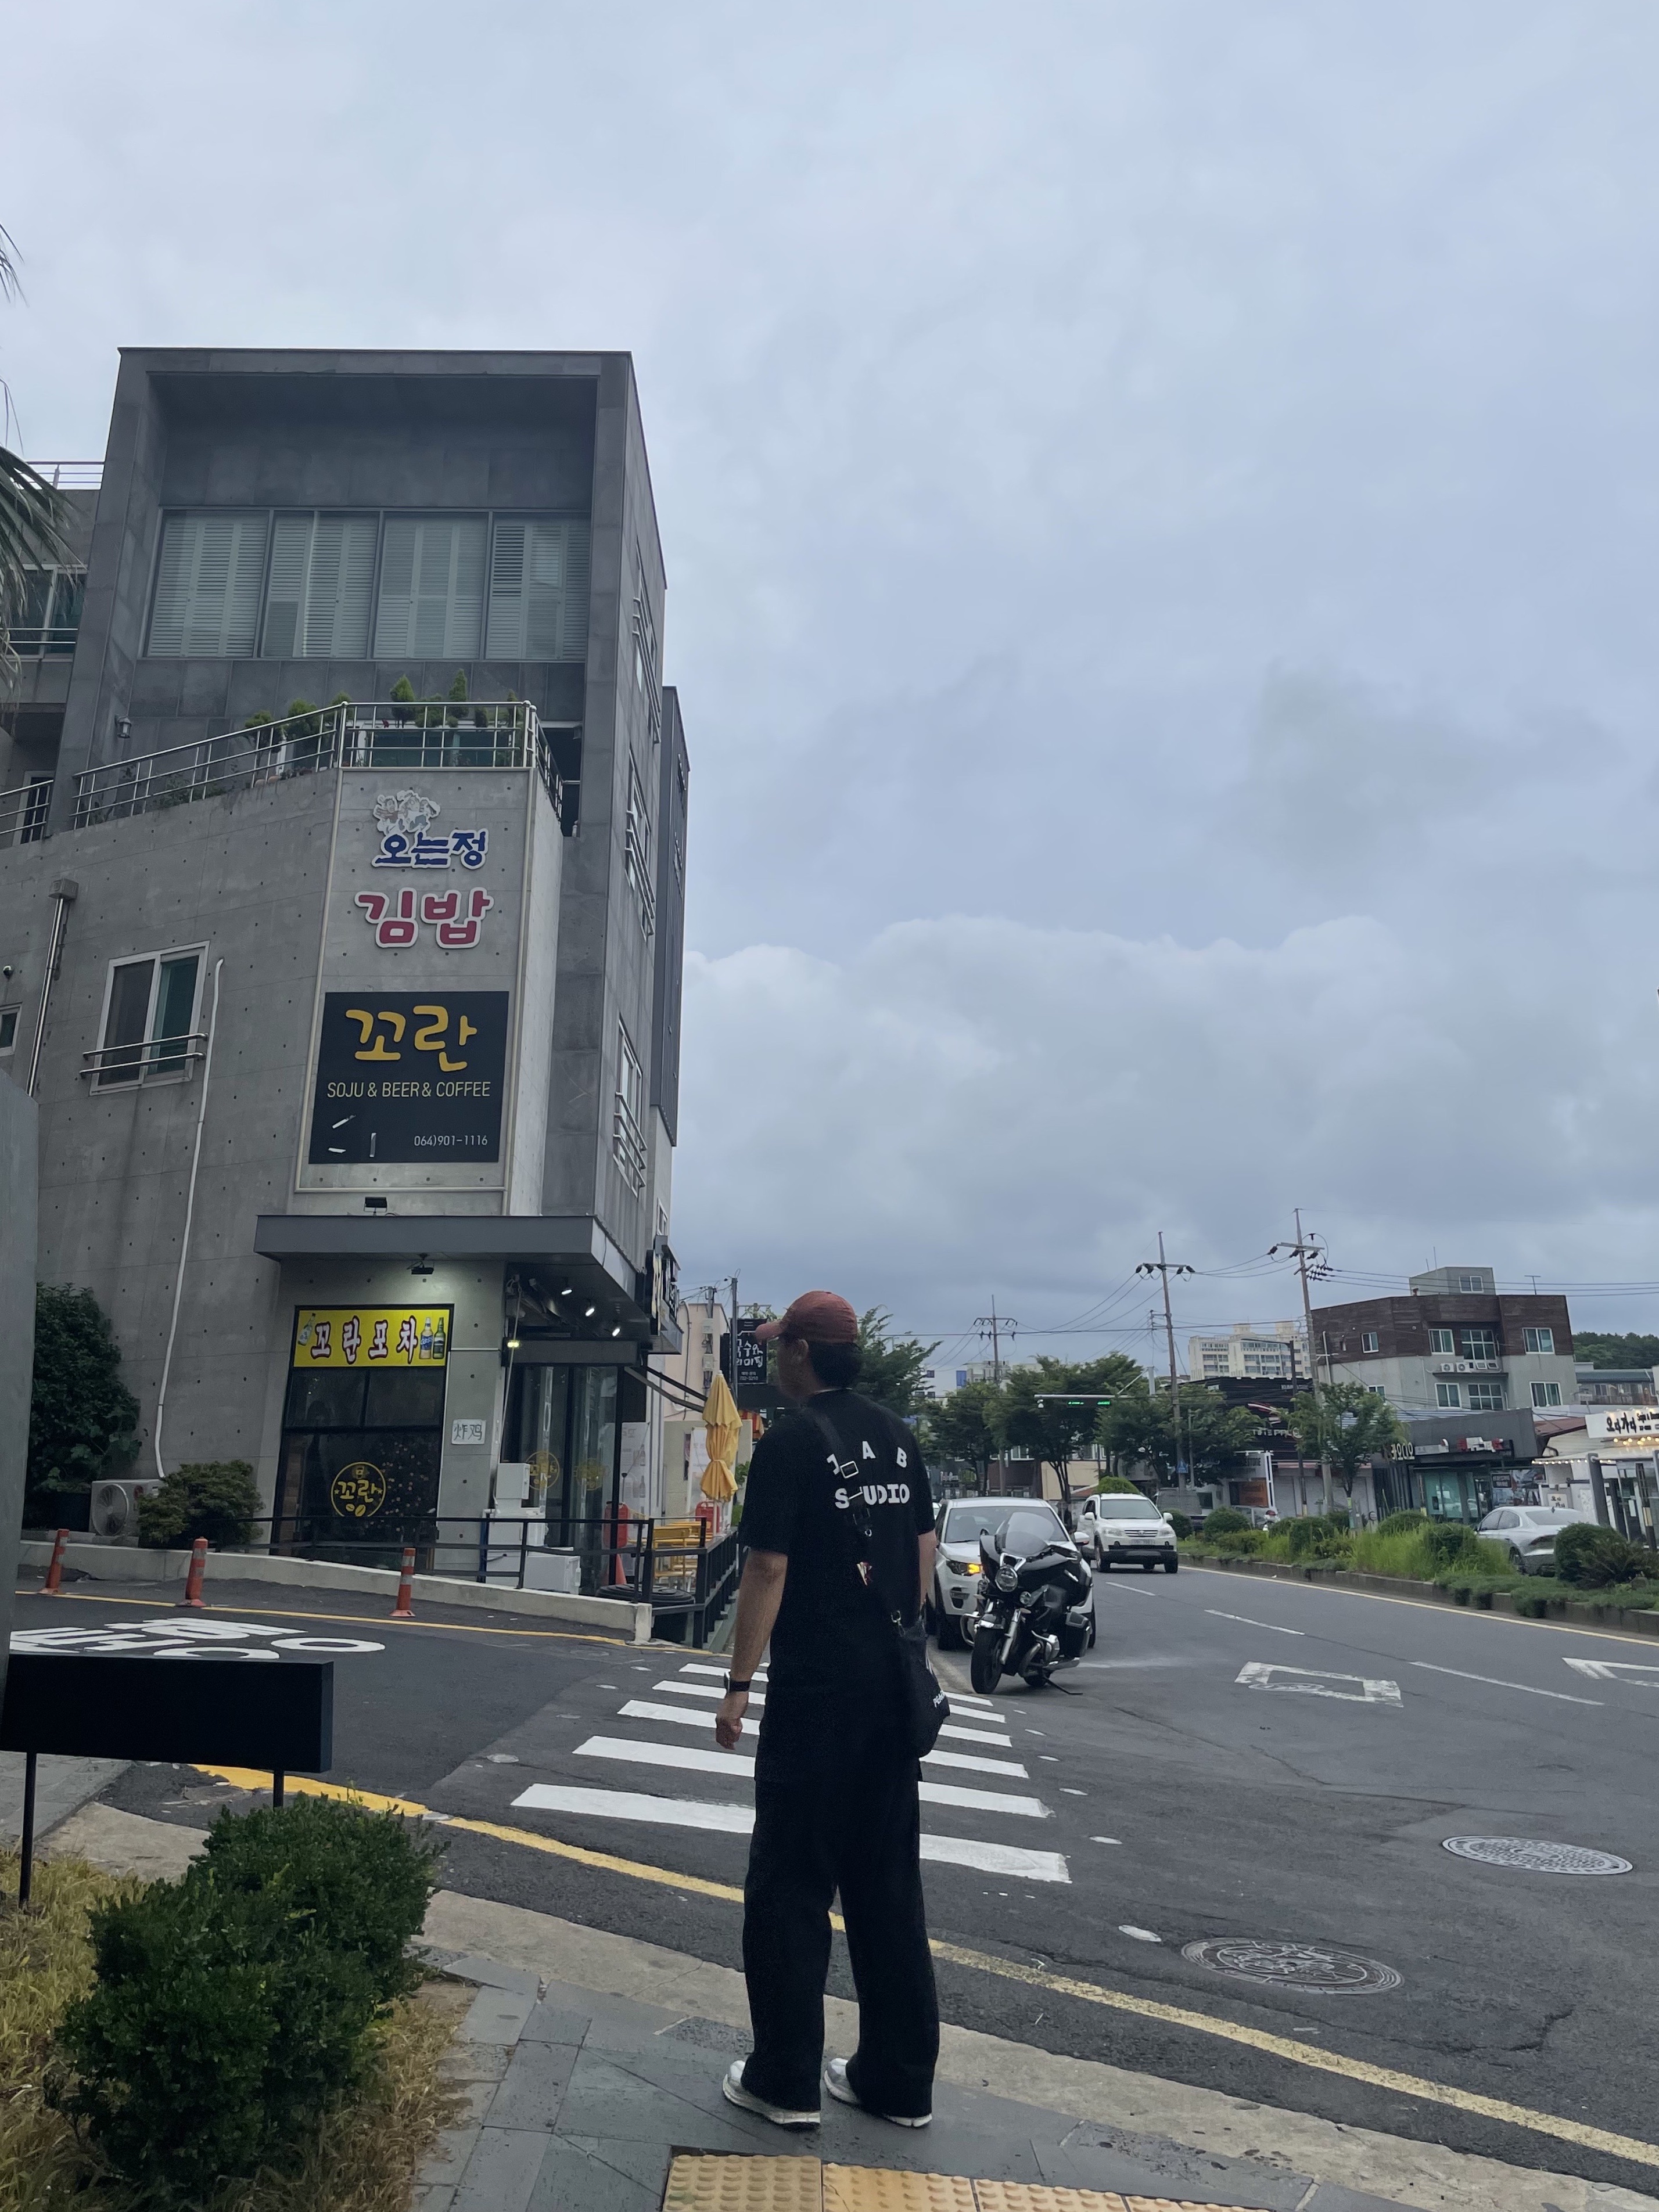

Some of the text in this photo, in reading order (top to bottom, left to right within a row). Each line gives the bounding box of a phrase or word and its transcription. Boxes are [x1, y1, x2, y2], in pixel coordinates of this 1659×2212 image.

[374, 830, 487, 868] 오는정
[357, 889, 492, 946] 김밥
[346, 1005, 477, 1072] 꼬란
[327, 1081, 491, 1097] SOJU & BEER & COFFEE
[414, 1135, 488, 1146] 064)901-1116
[311, 1315, 418, 1364] 꼬란포차
[454, 1424, 482, 1440] 炸鸡
[337, 1479, 378, 1503] 꼬란
[835, 1483, 910, 1509] SUDIO
